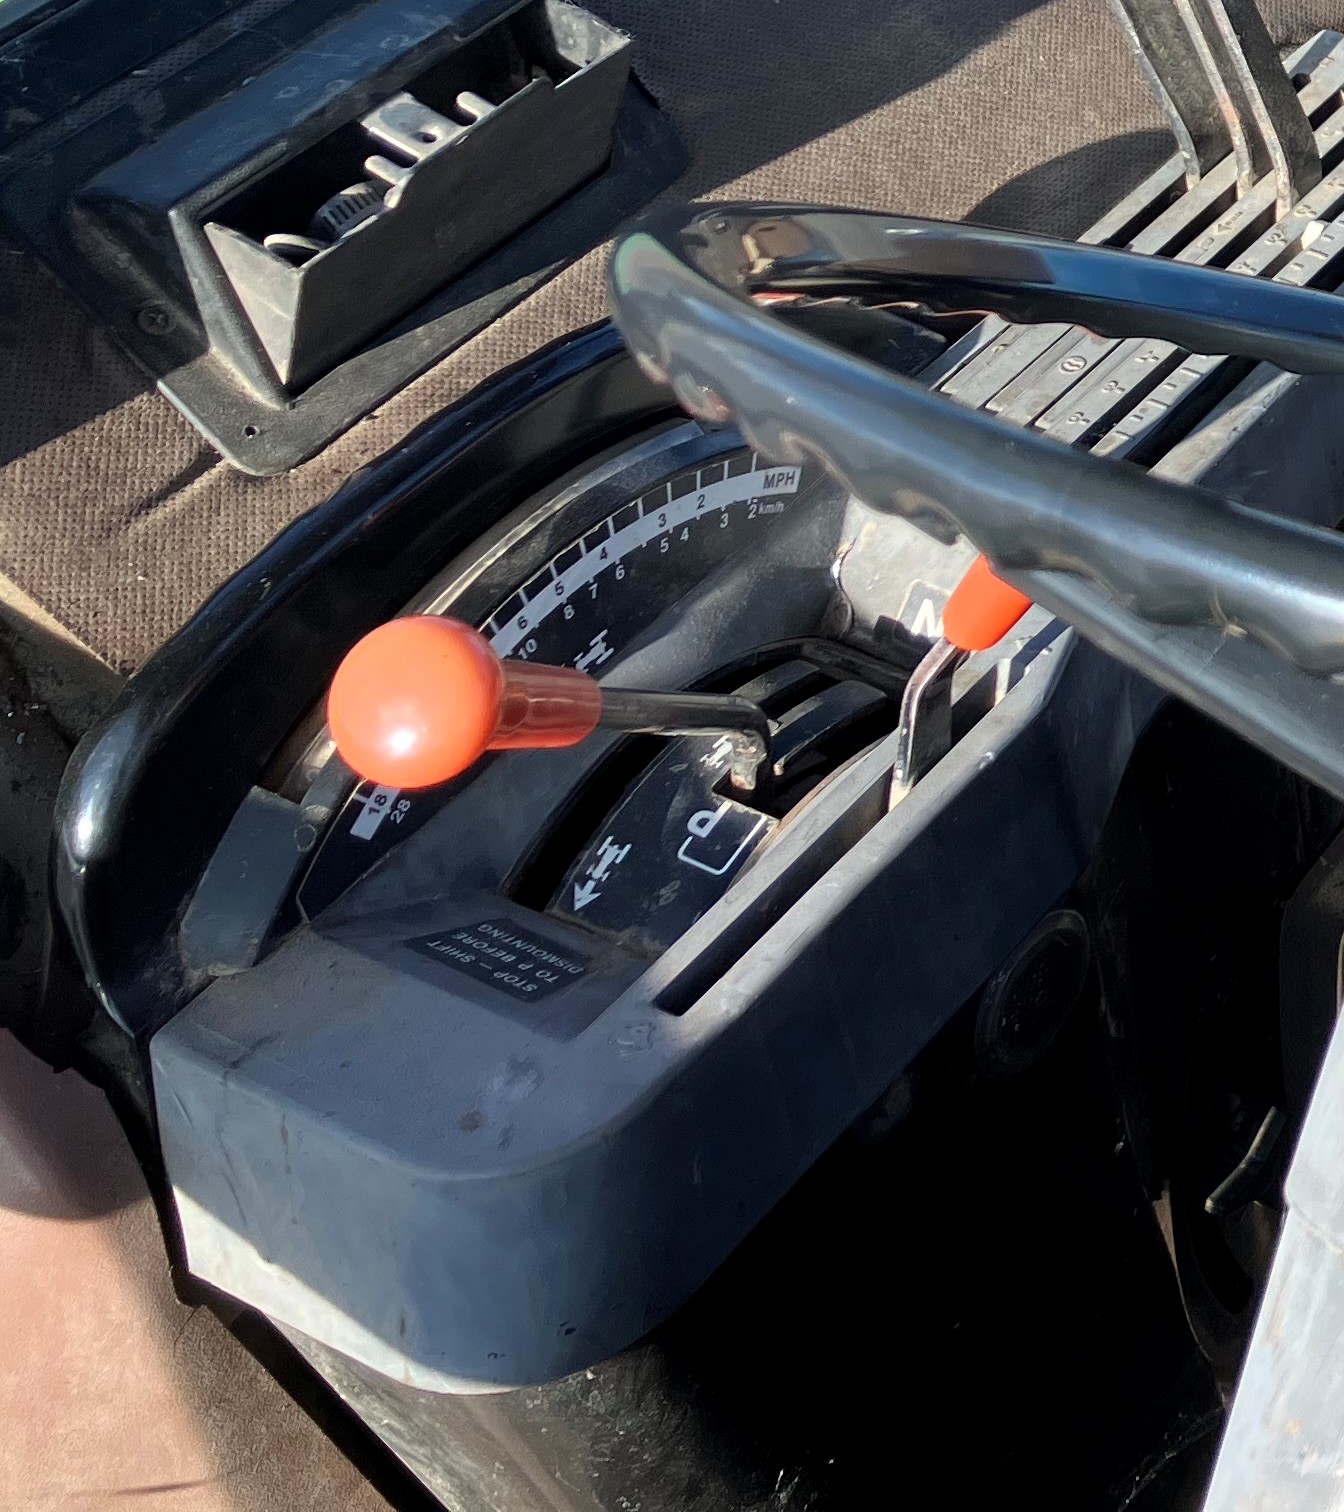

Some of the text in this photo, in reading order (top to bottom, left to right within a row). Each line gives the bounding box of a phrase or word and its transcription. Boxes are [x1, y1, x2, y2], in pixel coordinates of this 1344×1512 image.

[518, 471, 796, 629] 6 5 4 3 2 MPH
[518, 638, 538, 659] 10
[563, 604, 575, 620] 8
[588, 583, 598, 599] 7
[615, 565, 625, 580] 6
[660, 538, 669, 553] 5
[680, 527, 689, 542] 4
[720, 513, 729, 528] 3
[748, 505, 757, 520] 2
[368, 794, 387, 815] 18
[390, 799, 411, 824] 28
[687, 800, 733, 838] P
[427, 940, 476, 963] SHIFT
[453, 932, 560, 983] TO P BEFORE
[477, 924, 585, 974] DISMOUNTING
[493, 971, 539, 992] STOP
